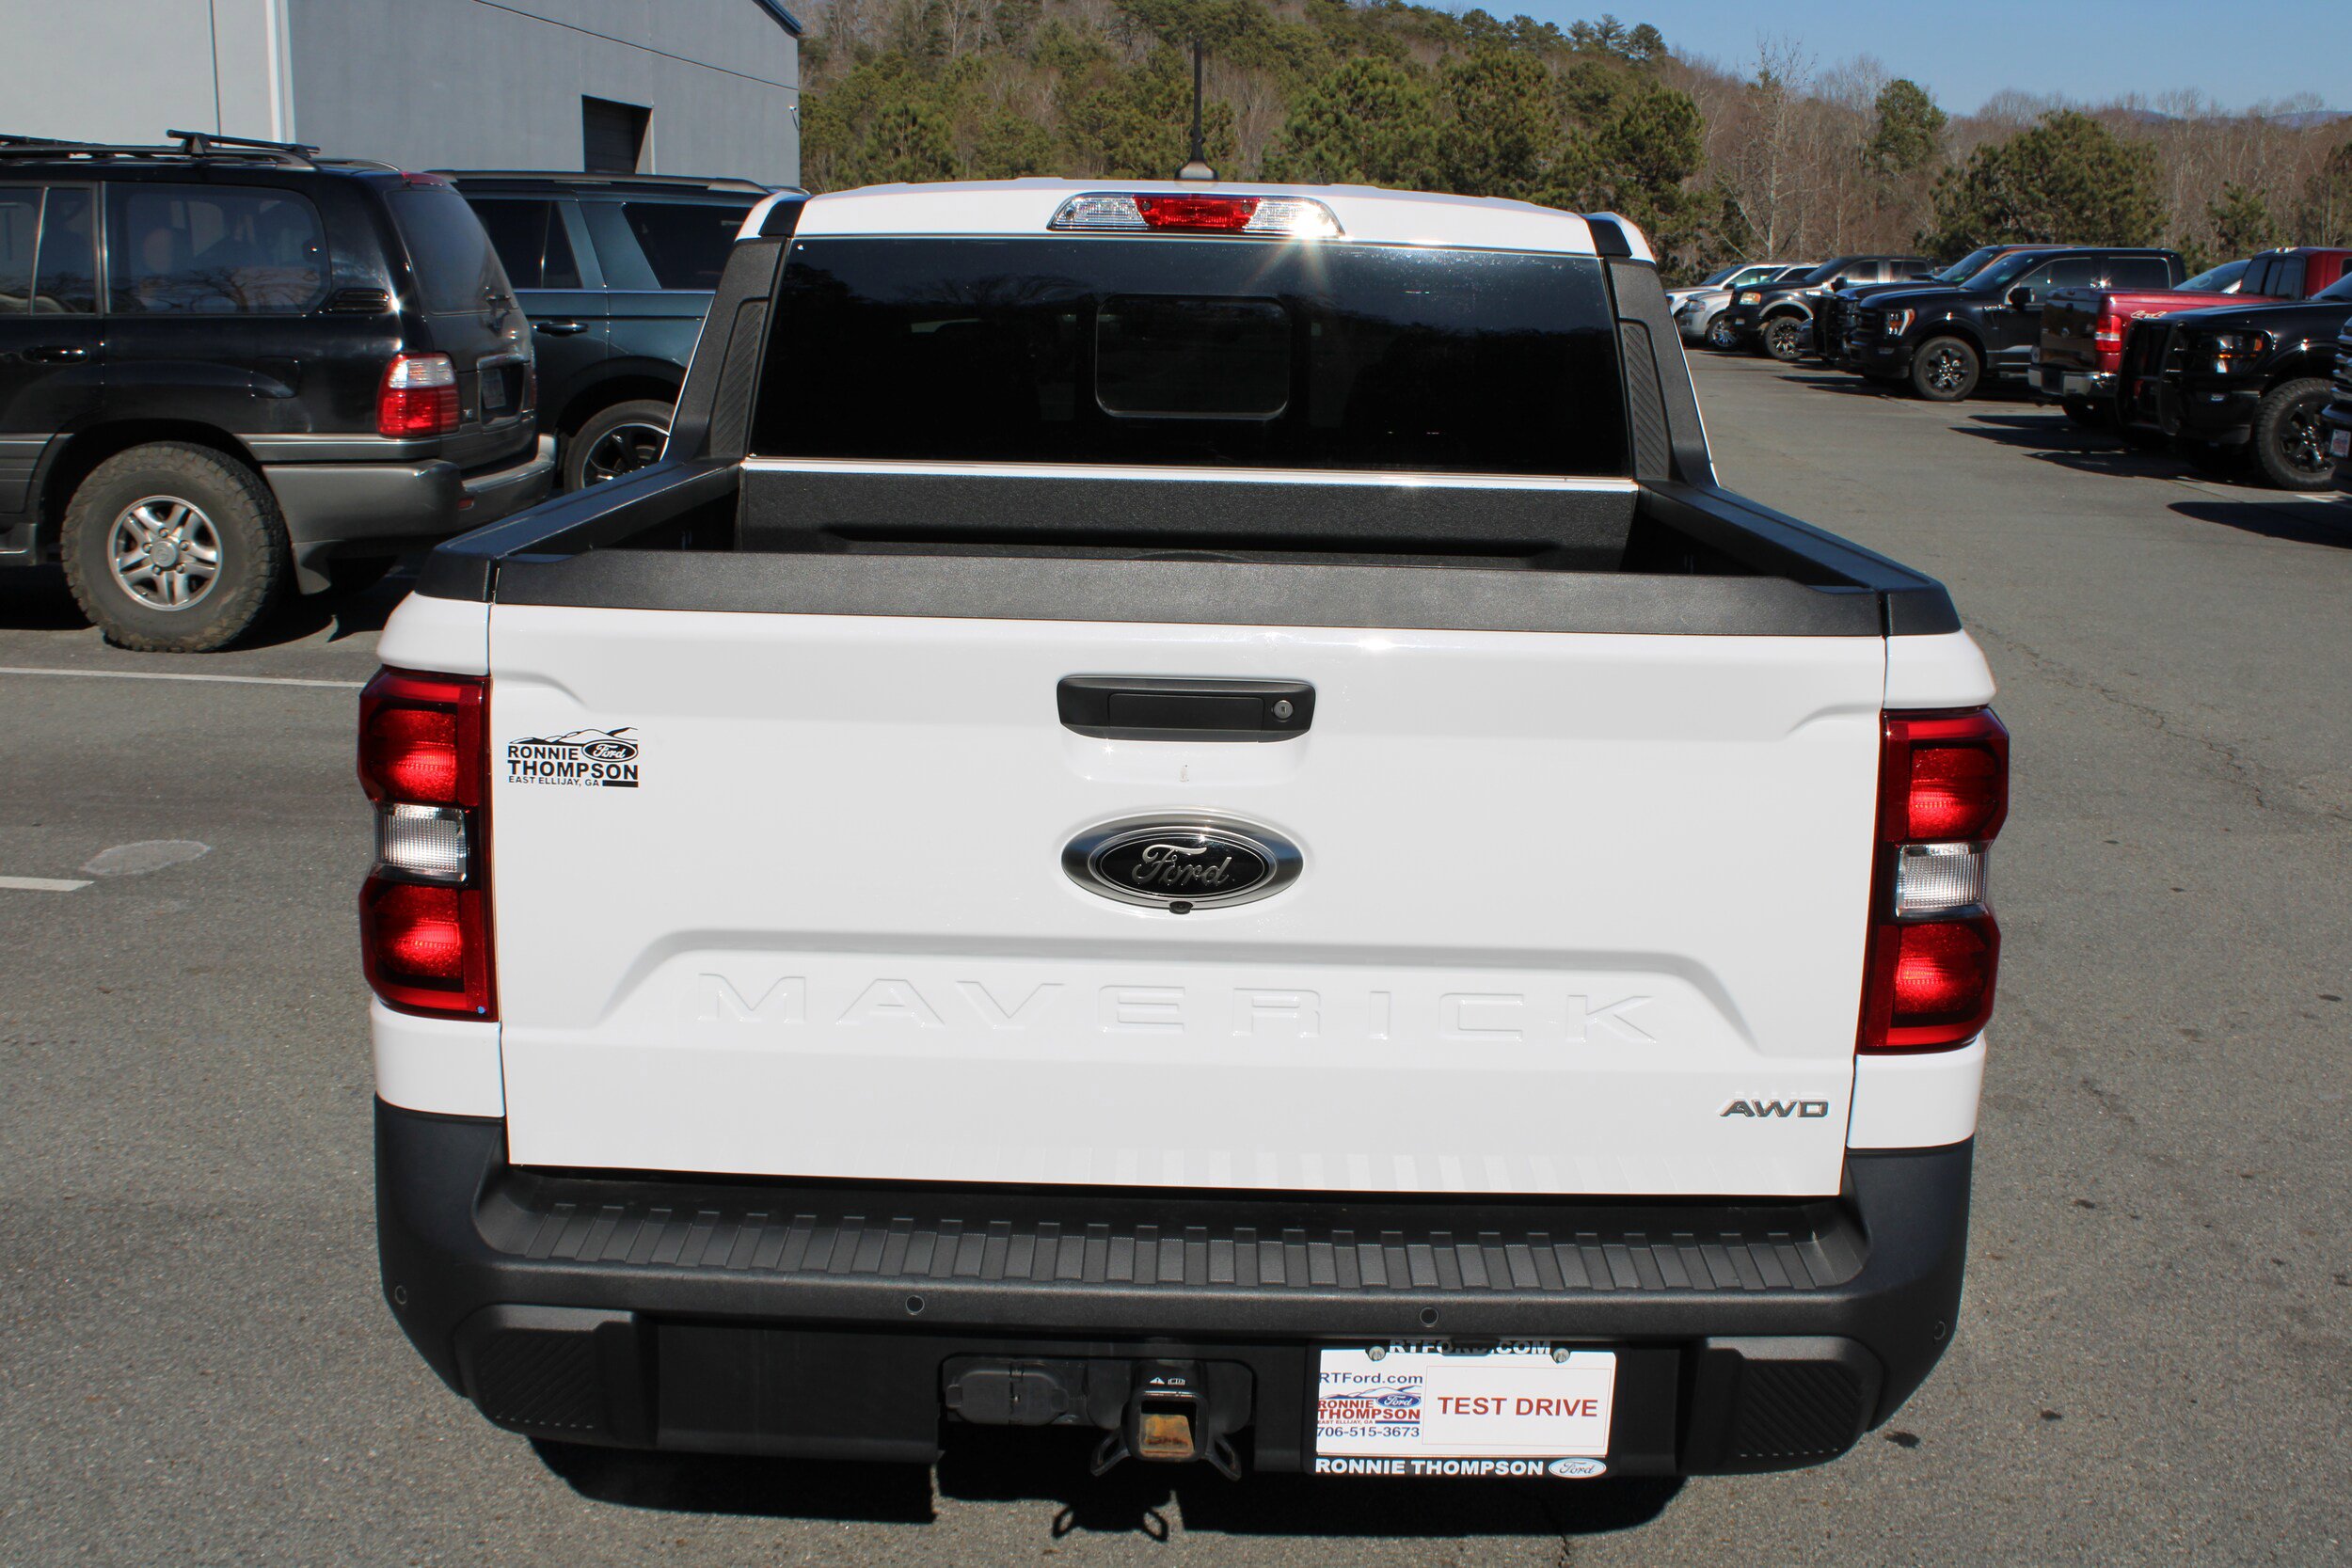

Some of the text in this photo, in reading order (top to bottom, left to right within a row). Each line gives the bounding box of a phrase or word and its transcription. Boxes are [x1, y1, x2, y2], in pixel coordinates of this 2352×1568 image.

[508, 743, 628, 760] RONNIE Ford
[507, 759, 639, 781] THOMPSON
[508, 775, 535, 784] EAST
[538, 777, 581, 787] ELLIJAY,
[1132, 844, 1234, 886] Ford
[698, 973, 1659, 1044] MAVERICK
[1720, 1099, 1830, 1117] AWD
[1319, 1372, 1422, 1384] RTFord.com
[1318, 1394, 1412, 1409] RONNIE Ford
[1438, 1396, 1598, 1418] TEST DRIVE
[1317, 1408, 1421, 1419] THOMPSON
[1317, 1426, 1420, 1437] 706-515-3673
[1315, 1458, 1596, 1476] RONNIE THOMPSON Ford
